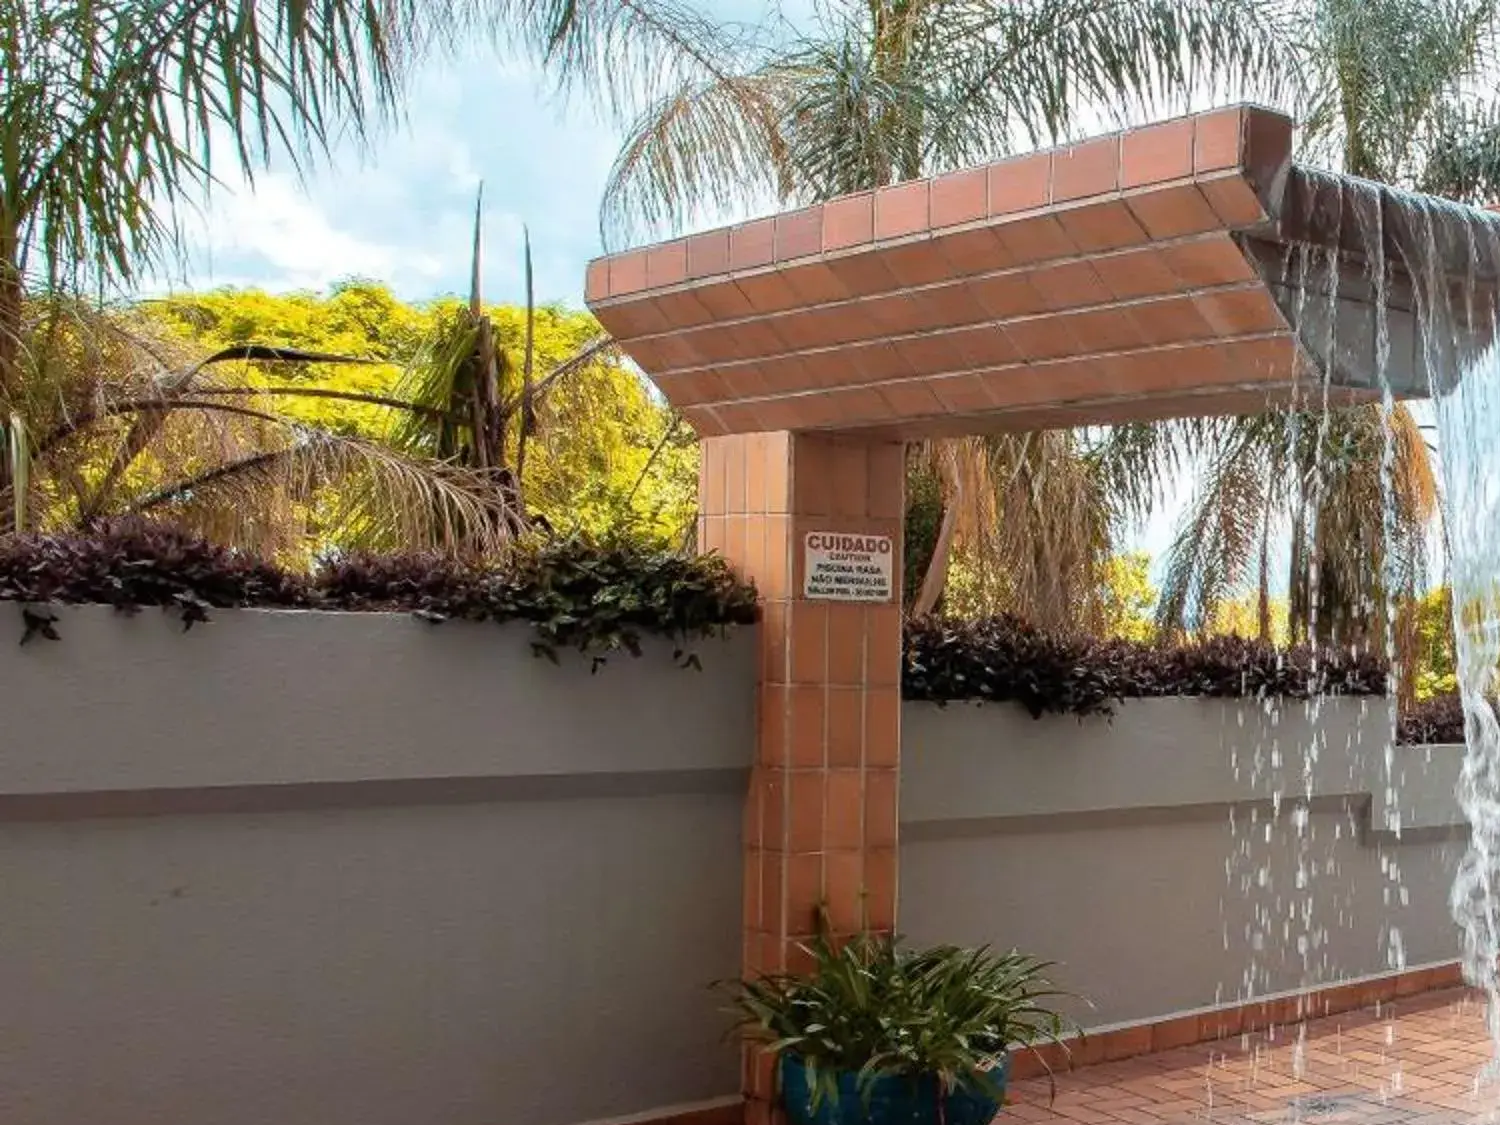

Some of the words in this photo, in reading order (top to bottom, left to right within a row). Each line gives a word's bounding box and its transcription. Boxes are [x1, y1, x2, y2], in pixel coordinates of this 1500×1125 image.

[808, 535, 890, 553] CUIDADO
[829, 553, 871, 562] CAUTION
[811, 573, 832, 584] NÃO
